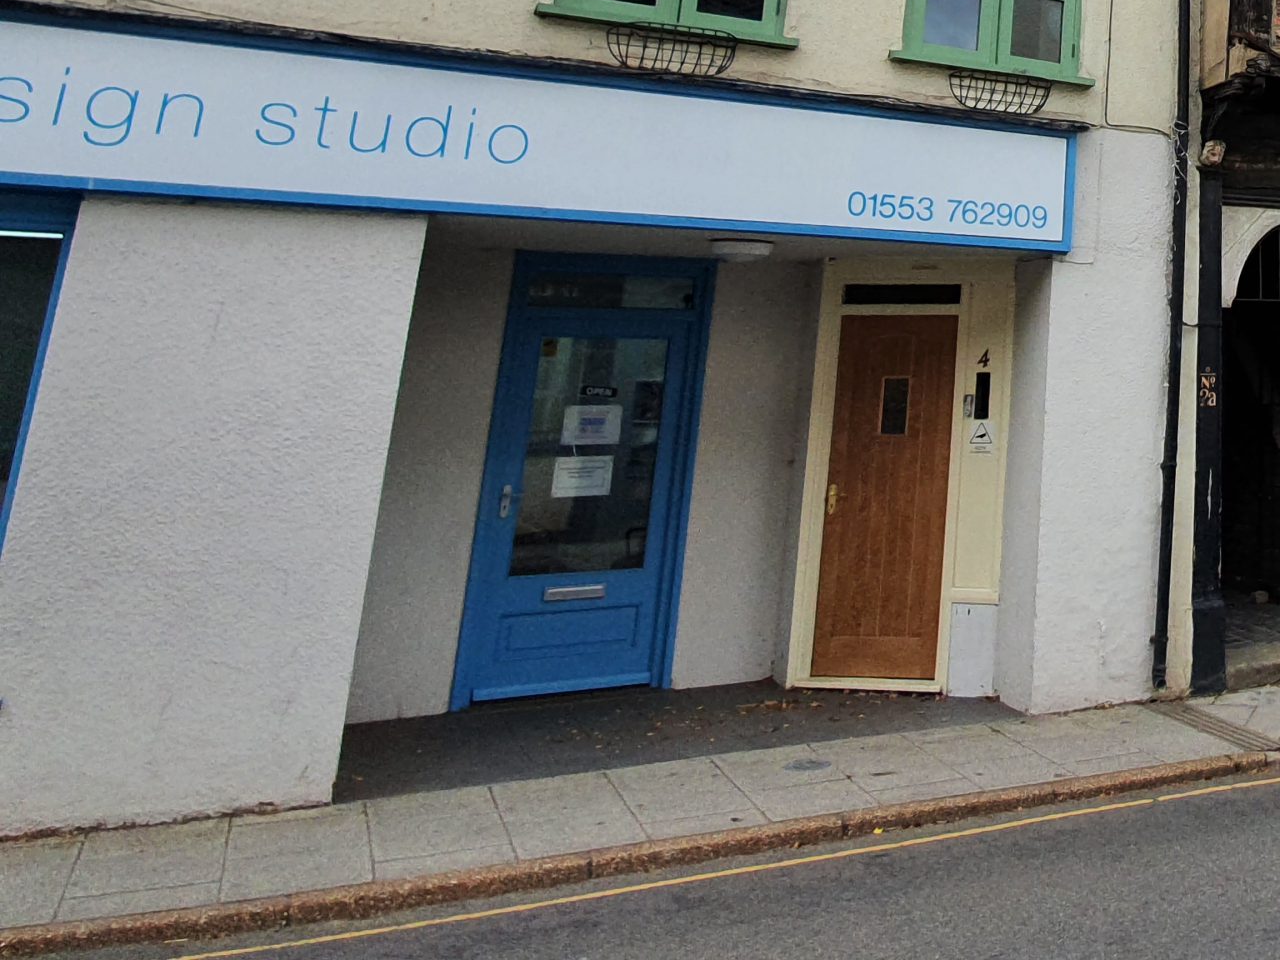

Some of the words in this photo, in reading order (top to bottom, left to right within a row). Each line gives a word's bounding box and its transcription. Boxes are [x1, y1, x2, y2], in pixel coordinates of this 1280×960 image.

[254, 95, 529, 165] studio
[847, 190, 935, 222] 01553
[946, 199, 1048, 229] 762909
[976, 348, 990, 369] 4
[586, 386, 613, 397] OPEN
